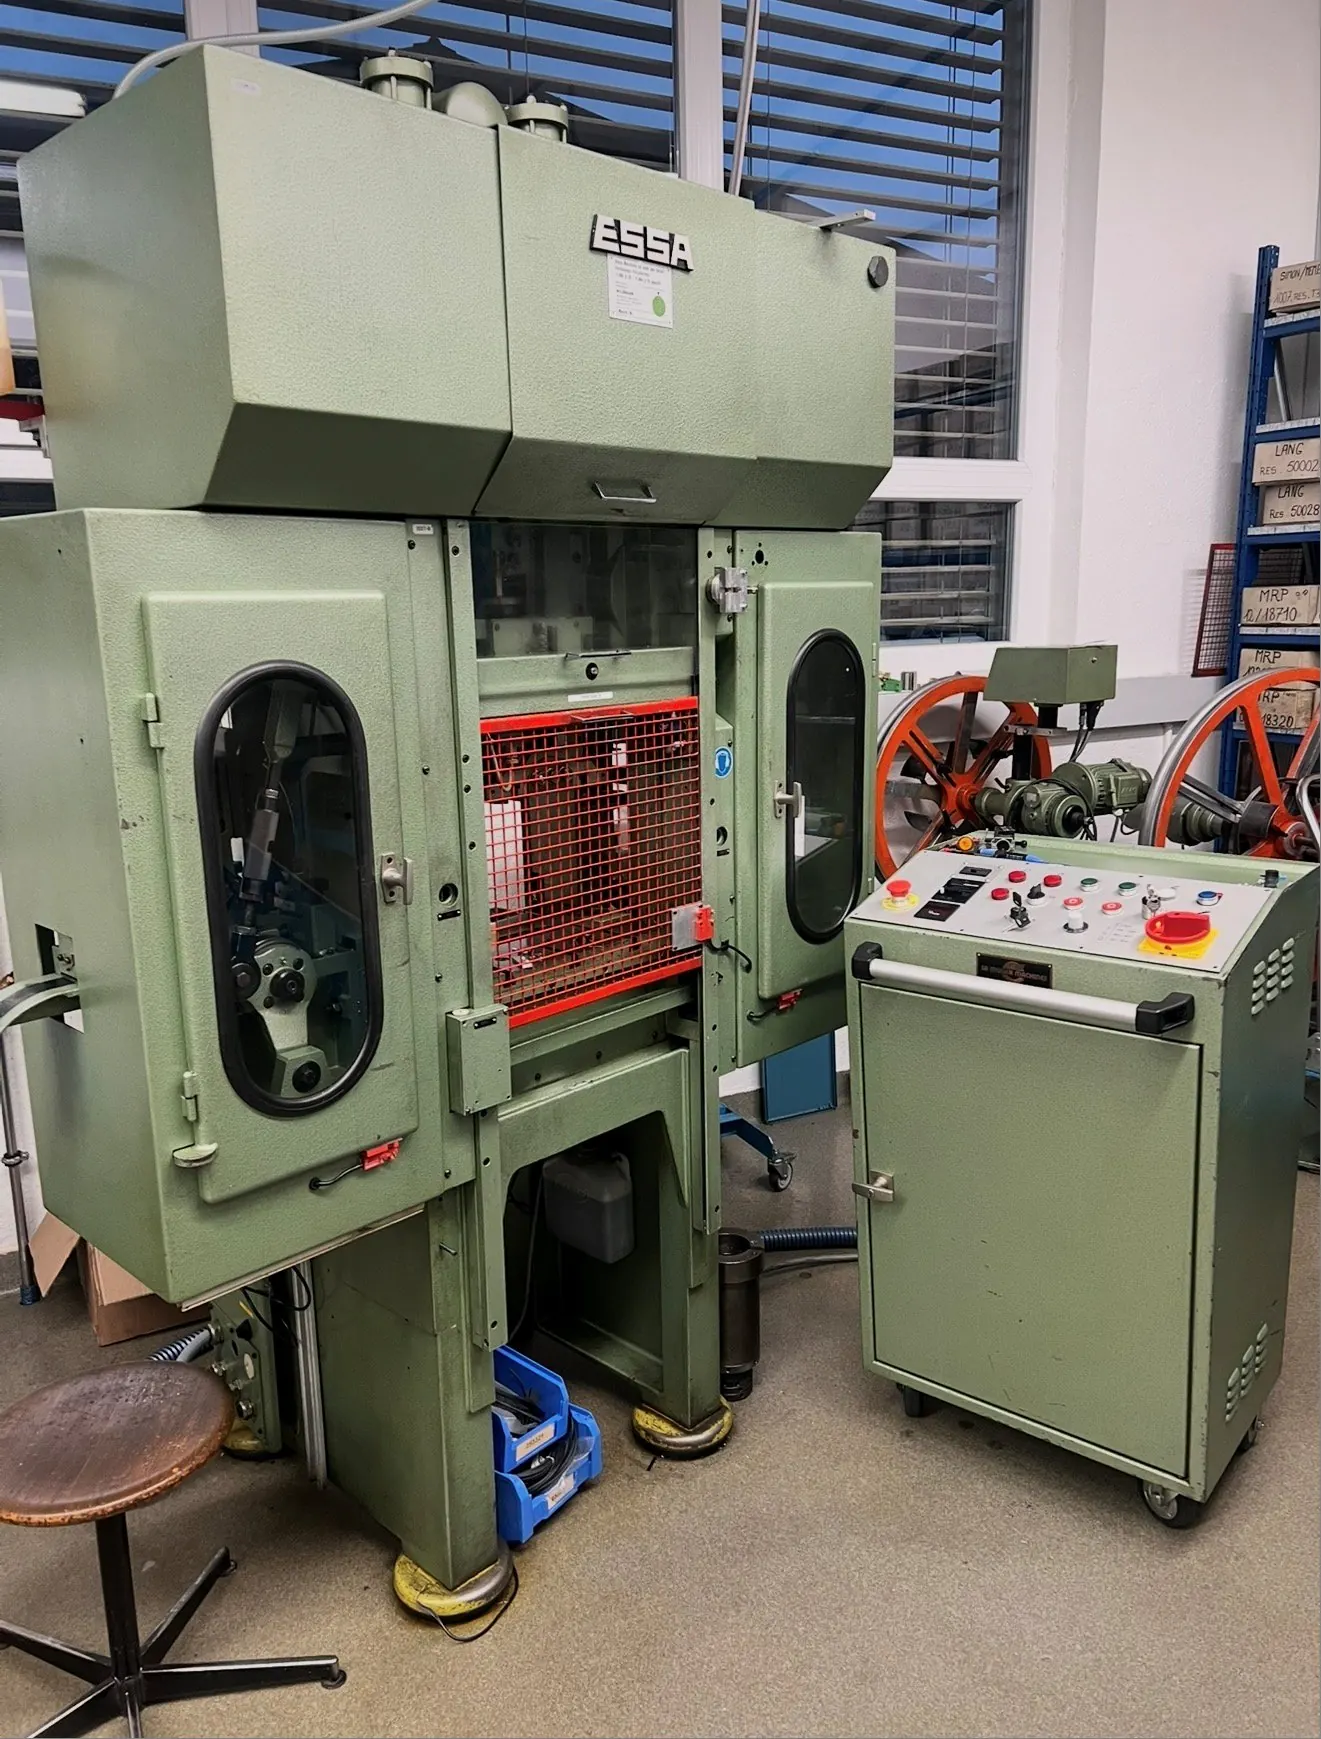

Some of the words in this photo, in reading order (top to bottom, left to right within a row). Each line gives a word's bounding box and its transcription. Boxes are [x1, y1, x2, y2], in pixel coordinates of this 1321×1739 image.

[591, 213, 694, 271] ESSA
[1275, 442, 1304, 457] LANG
[1286, 458, 1319, 473] 50002
[1277, 485, 1305, 499] LANG
[1290, 503, 1320, 517] 50028
[1259, 588, 1289, 602] MRP
[1255, 649, 1282, 664] MRP
[1257, 690, 1280, 704] RP
